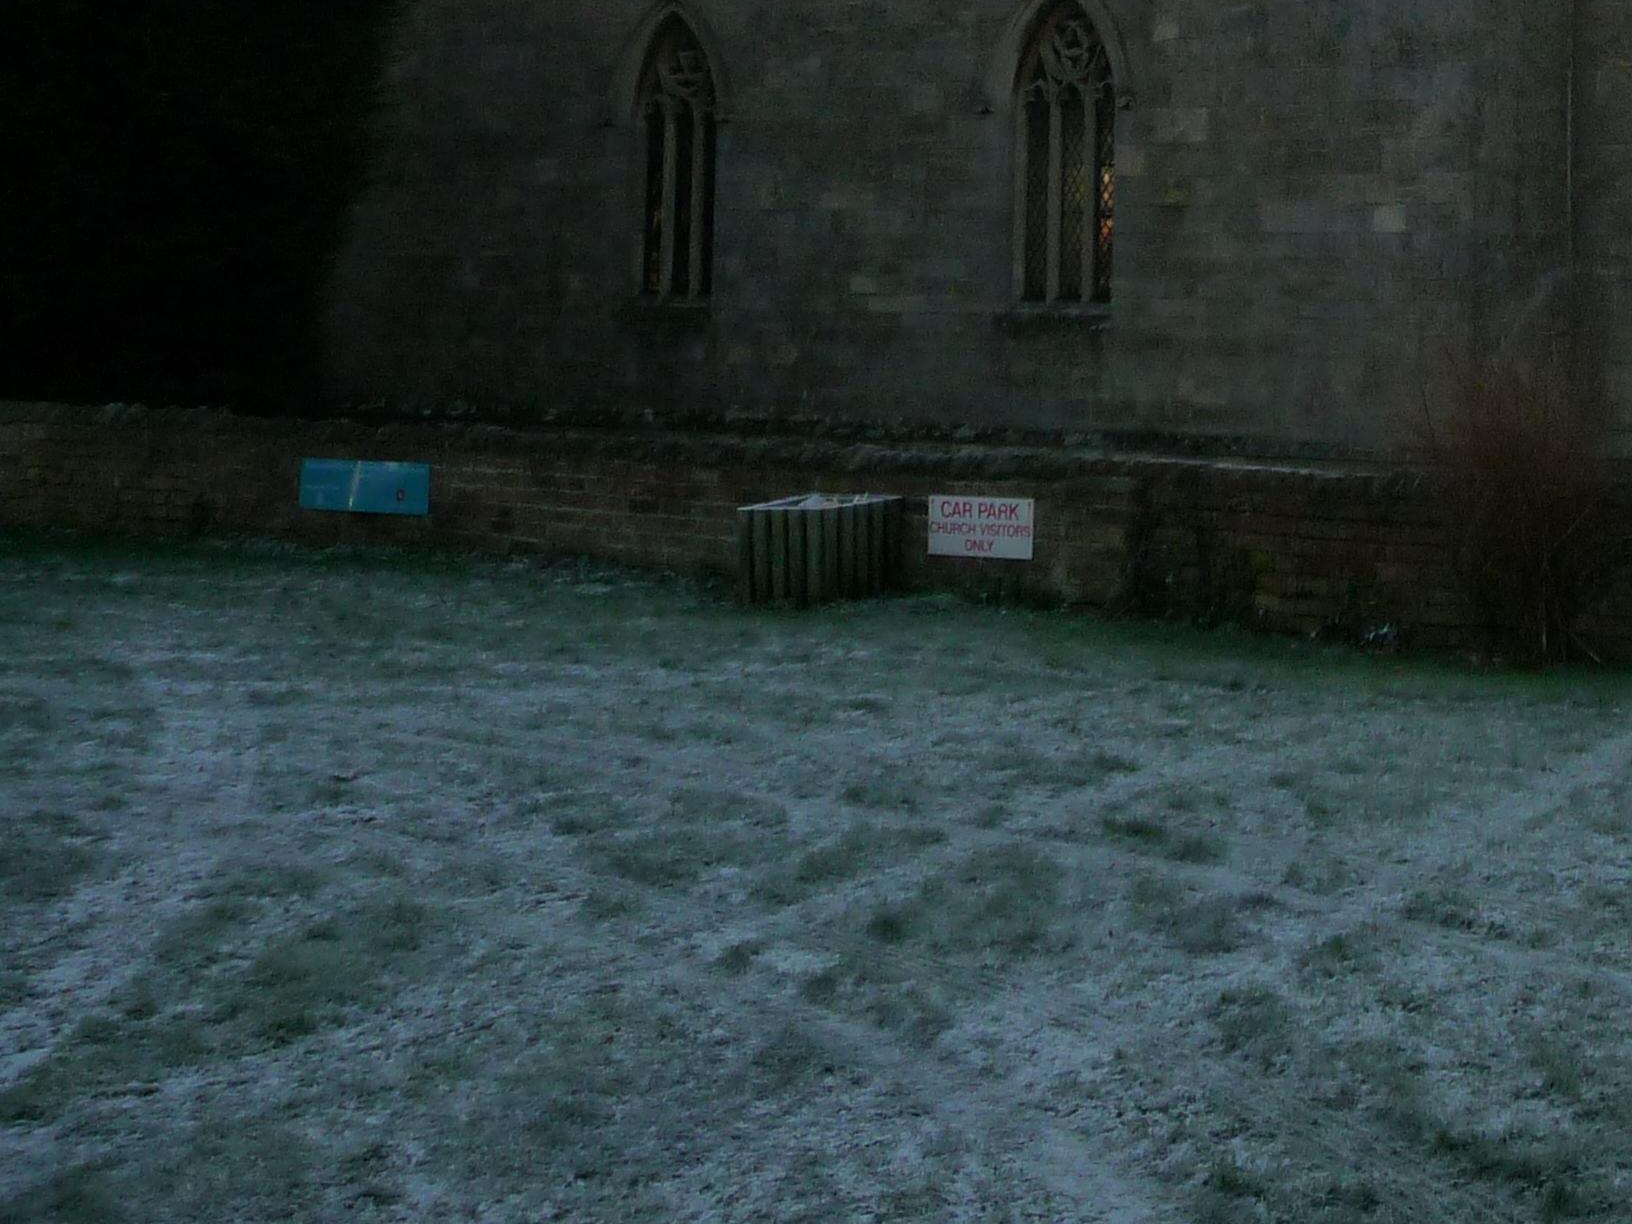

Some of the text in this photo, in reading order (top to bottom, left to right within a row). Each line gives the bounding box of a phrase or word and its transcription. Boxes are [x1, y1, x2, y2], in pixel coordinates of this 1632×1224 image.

[941, 501, 1019, 521] CAR PARK
[930, 521, 1031, 538] CHURCH VISITORS
[964, 539, 994, 552] ONLY
